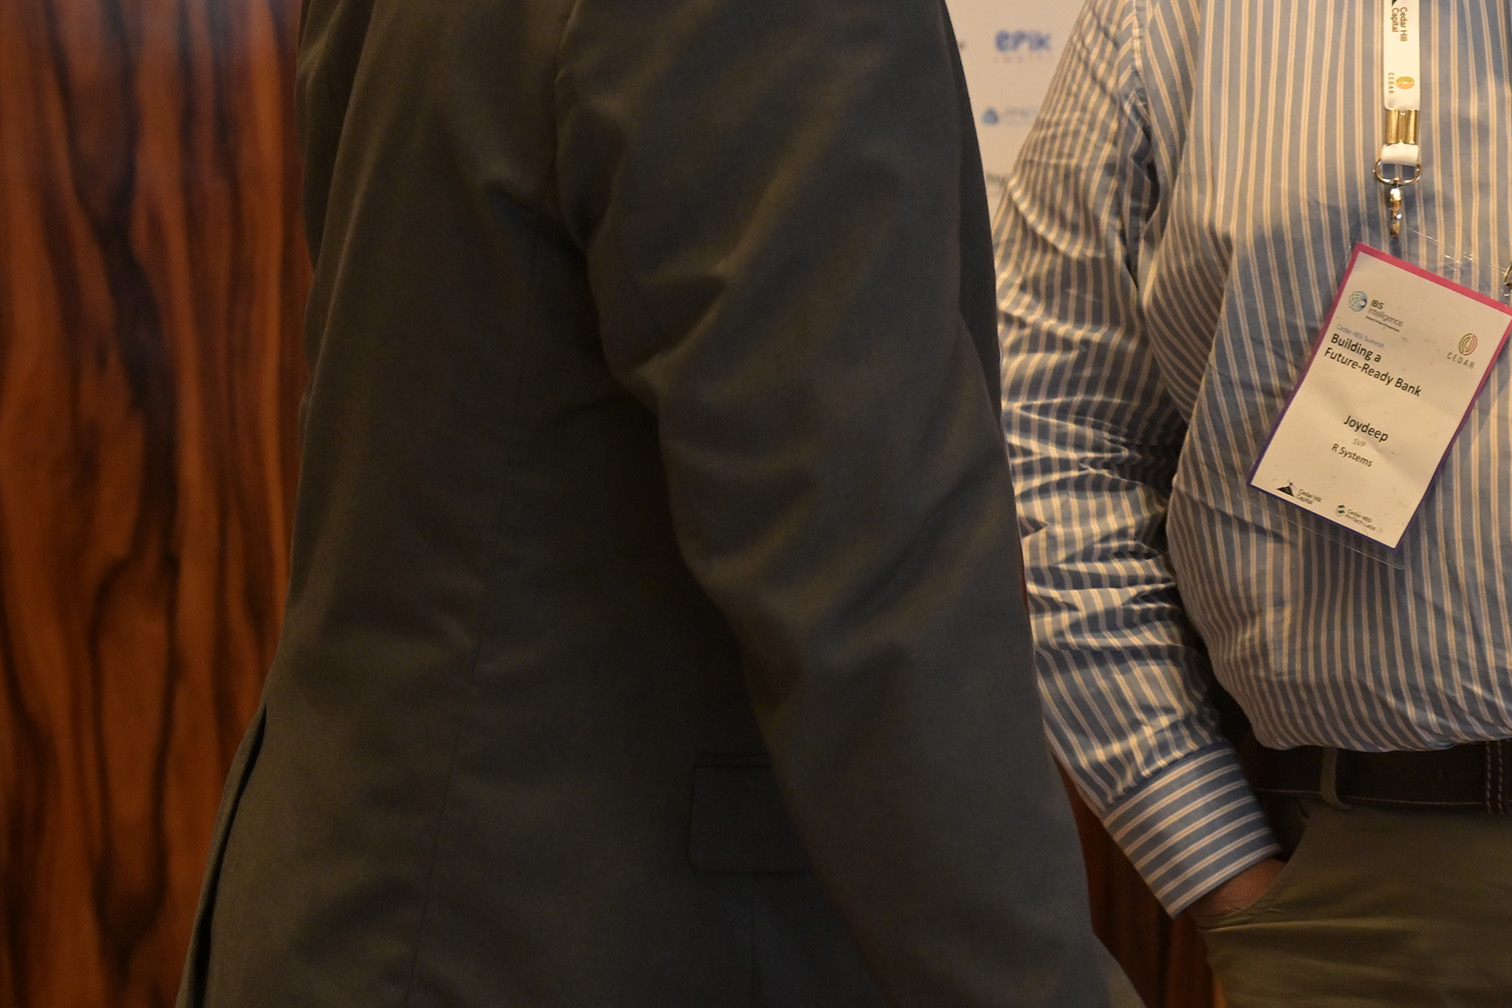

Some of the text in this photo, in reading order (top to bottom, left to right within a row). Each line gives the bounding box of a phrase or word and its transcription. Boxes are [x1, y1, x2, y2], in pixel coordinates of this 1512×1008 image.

[1390, 7, 1399, 33] Capital
[1400, 7, 1408, 42] Cedar Hill
[1370, 299, 1384, 310] IBS
[1330, 333, 1382, 363] Building a
[1446, 351, 1476, 369] CEDAR
[1323, 347, 1422, 397] Future-Ready Bank
[1343, 415, 1389, 443] Joydeep
[1331, 443, 1373, 467] R Systems
